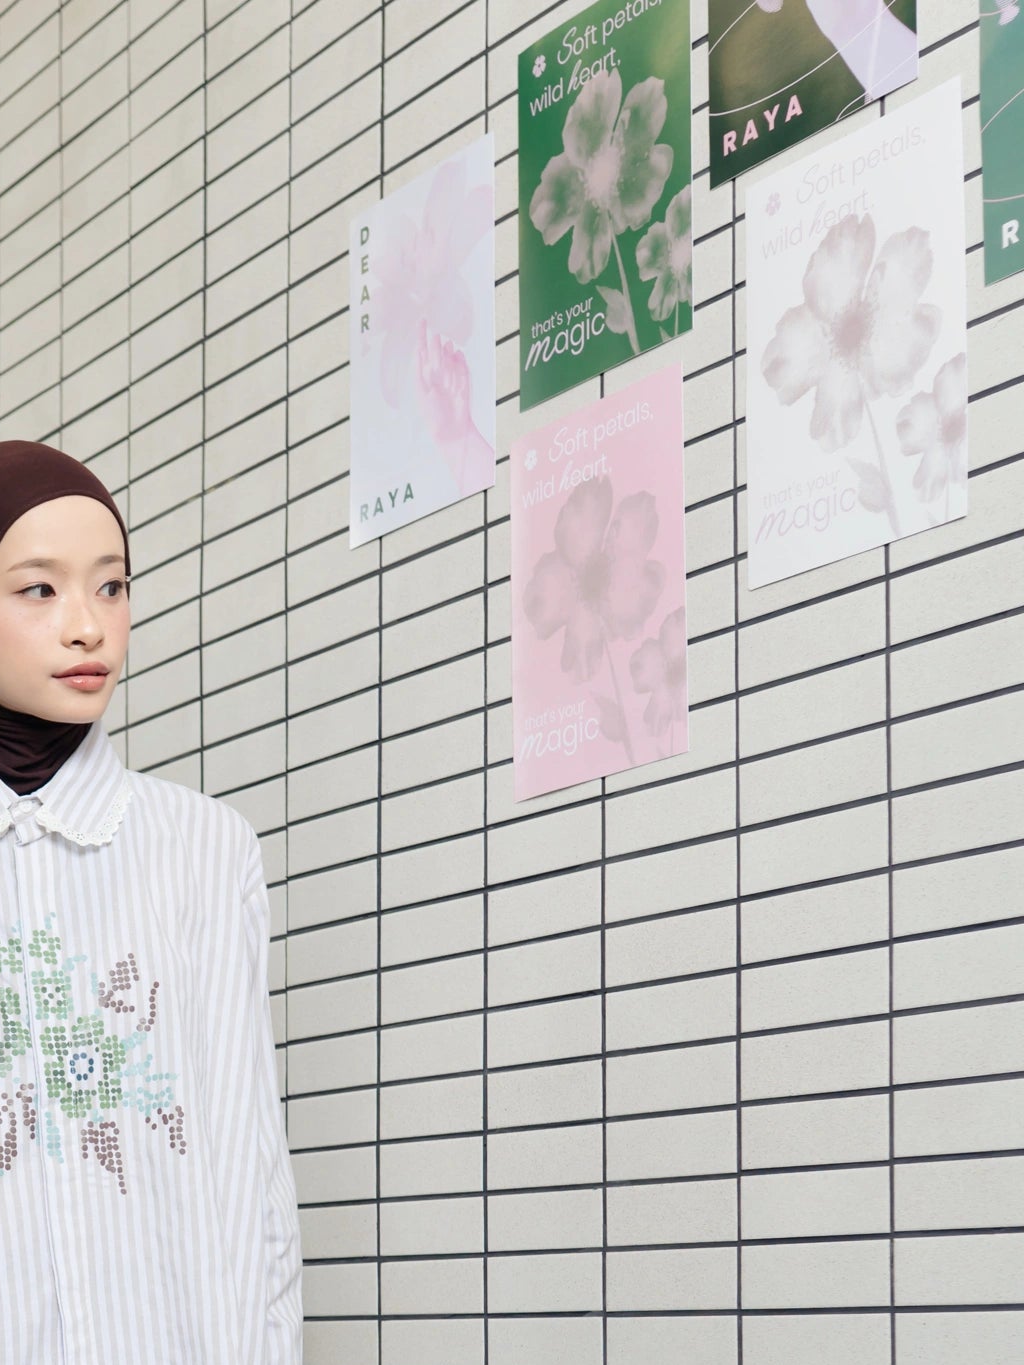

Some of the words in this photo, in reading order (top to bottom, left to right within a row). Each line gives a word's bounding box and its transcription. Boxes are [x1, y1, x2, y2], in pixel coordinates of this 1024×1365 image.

[557, 25, 597, 65] Soft
[530, 77, 563, 117] wild
[567, 47, 621, 94] heart,
[723, 94, 803, 157] RAYA
[796, 162, 845, 204] Soft
[762, 219, 803, 260] wild
[360, 226, 370, 334] DEAR
[524, 312, 605, 371] magic
[531, 311, 563, 339] that's
[565, 297, 594, 325] your
[548, 426, 588, 462] Soft
[593, 401, 654, 451] petals,
[360, 483, 414, 523] RAYA
[522, 474, 555, 509] wild
[559, 453, 612, 493] heart,
[762, 480, 801, 509] that's
[807, 470, 840, 499] your
[755, 486, 856, 544] magic
[558, 700, 586, 723] your
[518, 715, 599, 763] magic
